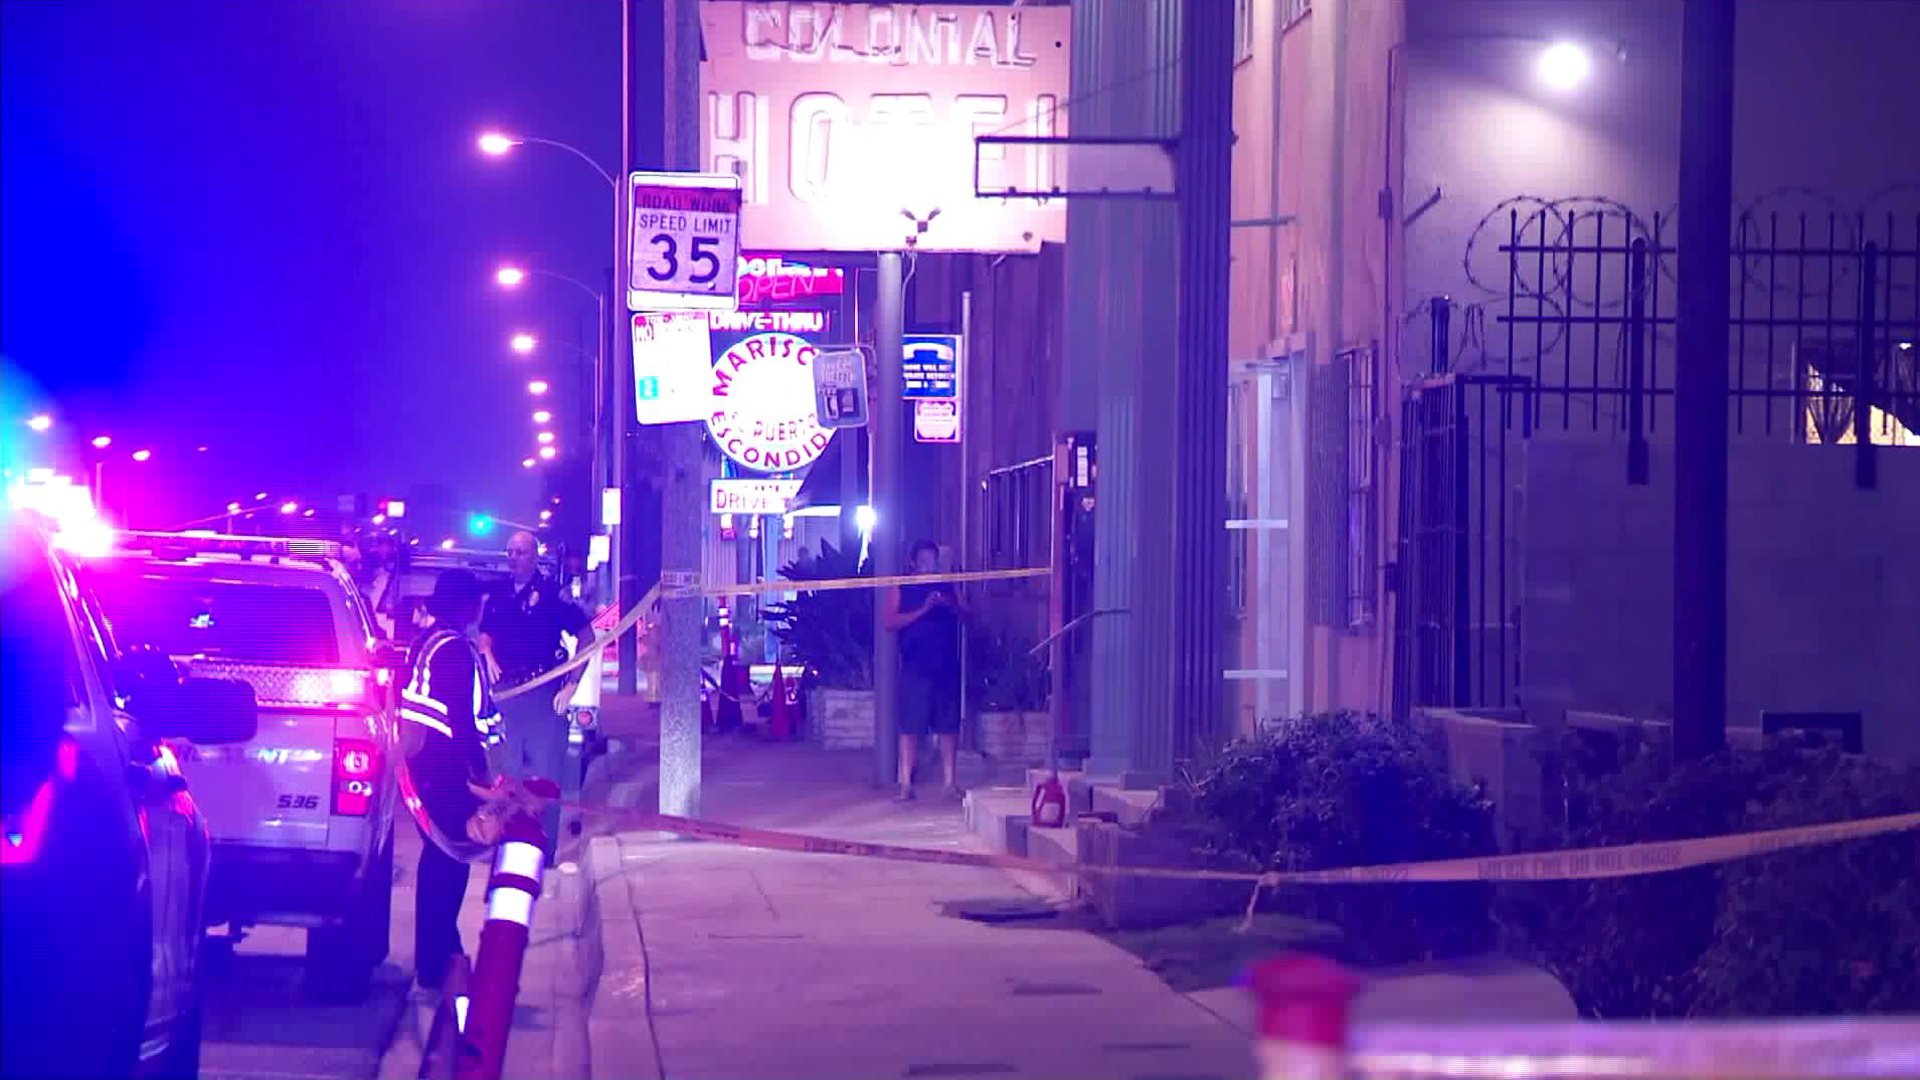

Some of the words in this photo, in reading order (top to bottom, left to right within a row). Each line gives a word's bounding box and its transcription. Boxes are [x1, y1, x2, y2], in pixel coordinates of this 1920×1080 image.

[742, 3, 1037, 67] COLONIAL
[639, 212, 687, 231] SPEED
[694, 217, 732, 234] LIMIT
[647, 233, 720, 284] 35
[712, 336, 817, 396] MARISC
[711, 410, 828, 467] ESCONDID
[753, 412, 816, 442] PUERTO
